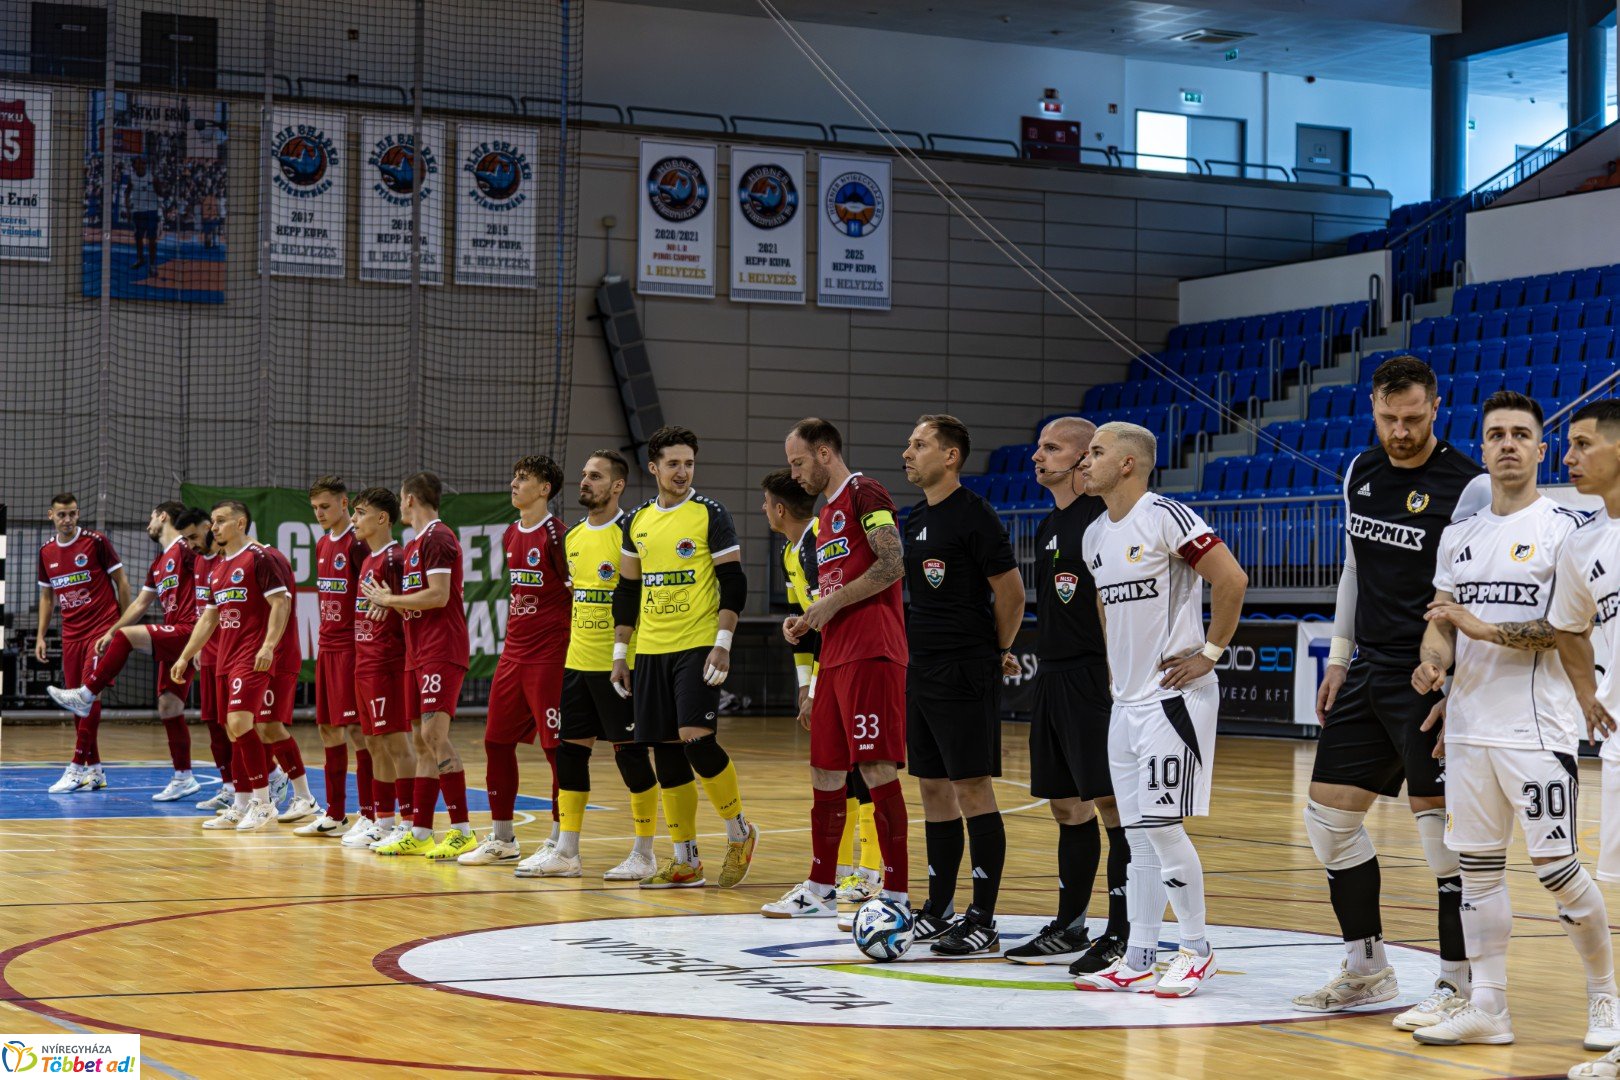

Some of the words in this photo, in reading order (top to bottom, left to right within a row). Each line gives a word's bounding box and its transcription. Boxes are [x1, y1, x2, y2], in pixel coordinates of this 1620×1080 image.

[291, 211, 314, 223] 2017
[303, 226, 329, 239] KUPA
[487, 223, 509, 236] 2019
[655, 228, 699, 242] 2020/2021
[376, 233, 402, 244] HEPP
[758, 242, 778, 254] 2021
[845, 248, 865, 260] 2025
[745, 256, 768, 267] HEPP
[769, 257, 791, 268] KUPA
[832, 262, 854, 272] HEPP
[855, 263, 877, 274] KUPA
[656, 264, 706, 279] HELYEZÉS
[748, 271, 797, 285] HELYEZÉS
[837, 276, 884, 292] HELYEZÉS
[643, 603, 691, 615] STUDIO
[1259, 646, 1294, 672] 90
[232, 677, 242, 695] 9
[421, 673, 441, 694] 28
[1266, 688, 1290, 702] KFT
[370, 697, 386, 719] 17
[853, 714, 880, 739] 33
[858, 743, 875, 751] JAKO
[1147, 755, 1181, 791] 10
[1522, 780, 1567, 821] 30
